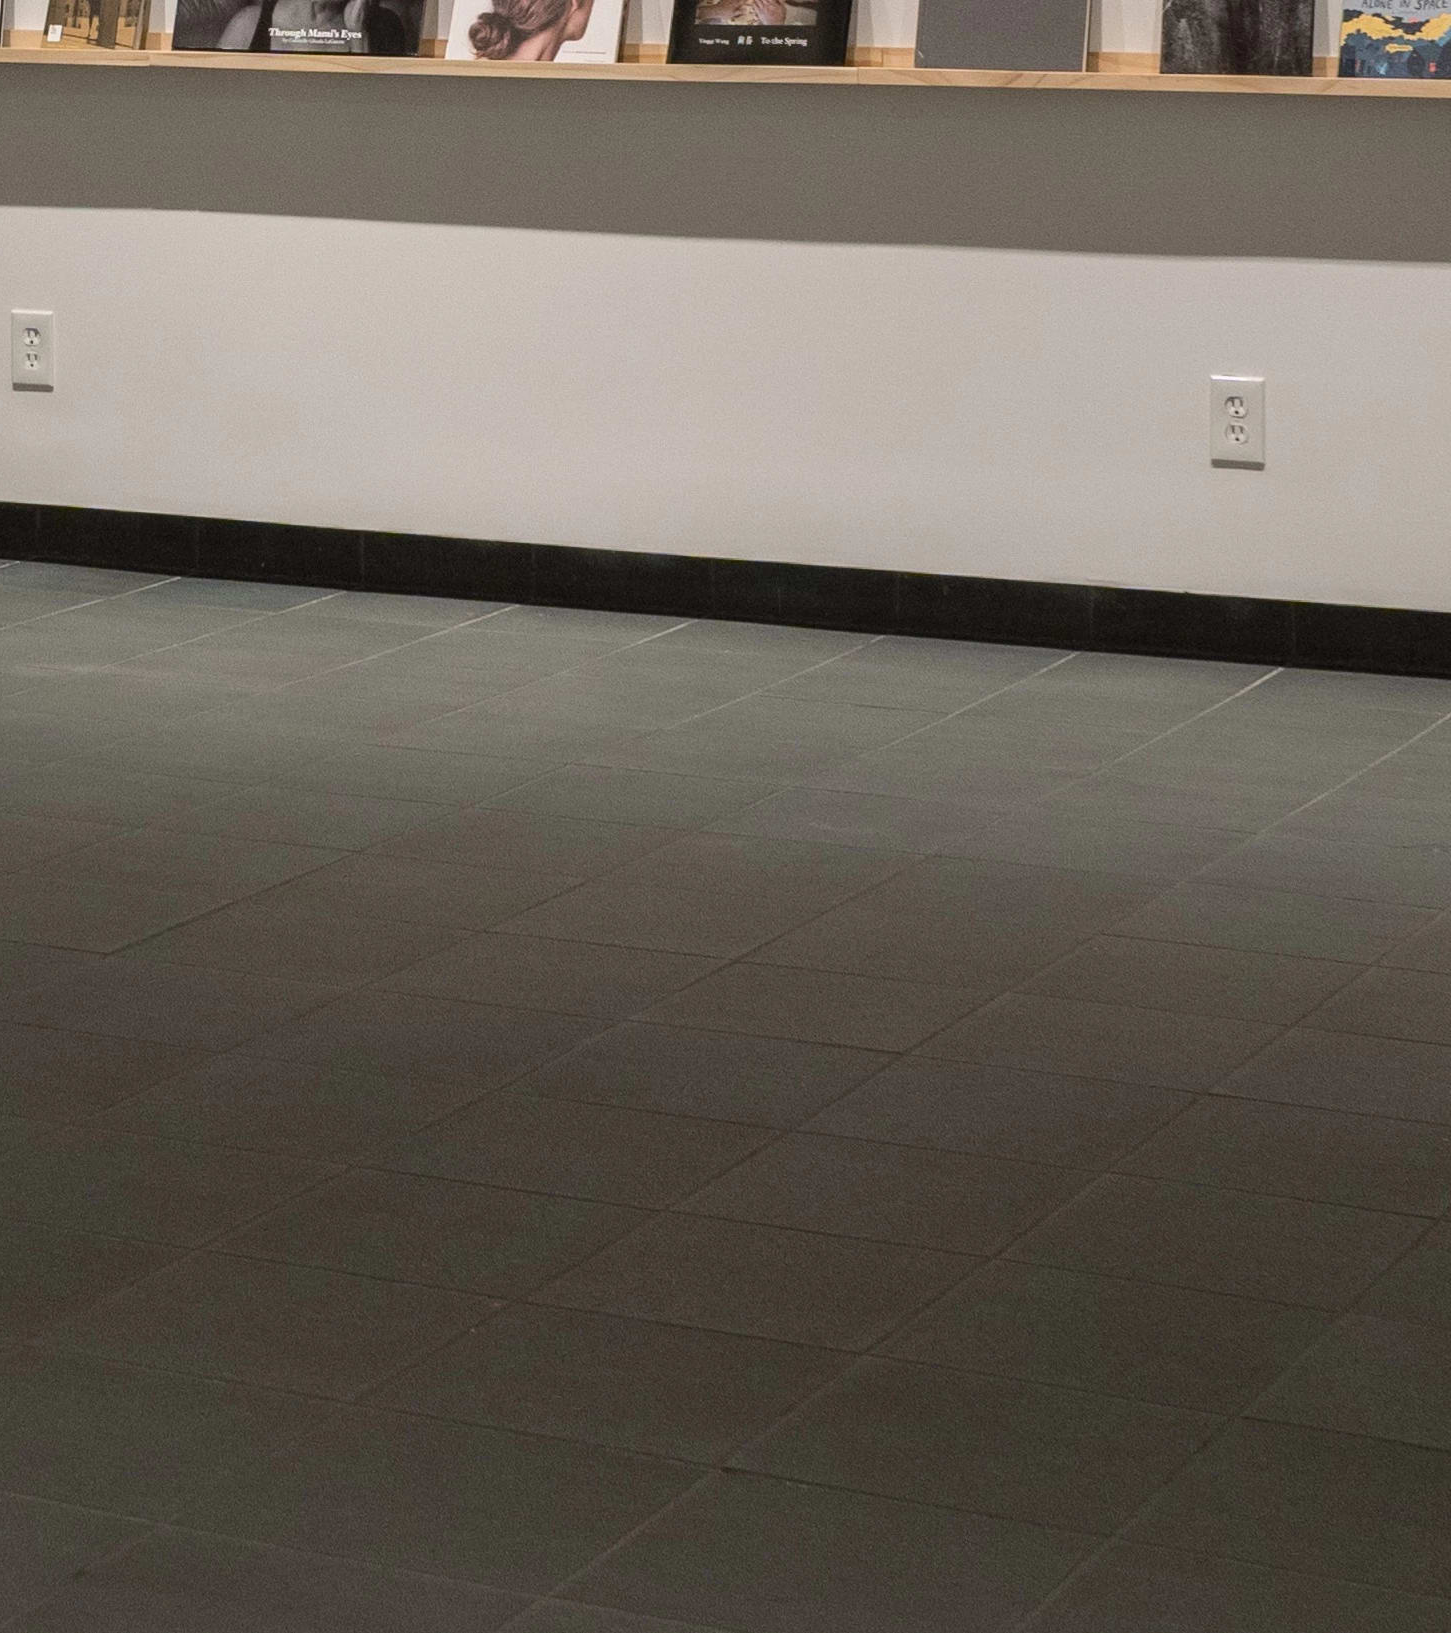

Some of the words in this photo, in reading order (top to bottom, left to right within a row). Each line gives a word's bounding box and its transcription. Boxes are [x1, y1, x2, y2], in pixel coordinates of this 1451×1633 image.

[1399, 0, 1411, 8] IN
[267, 27, 307, 41] Through
[340, 29, 363, 41] Eyes
